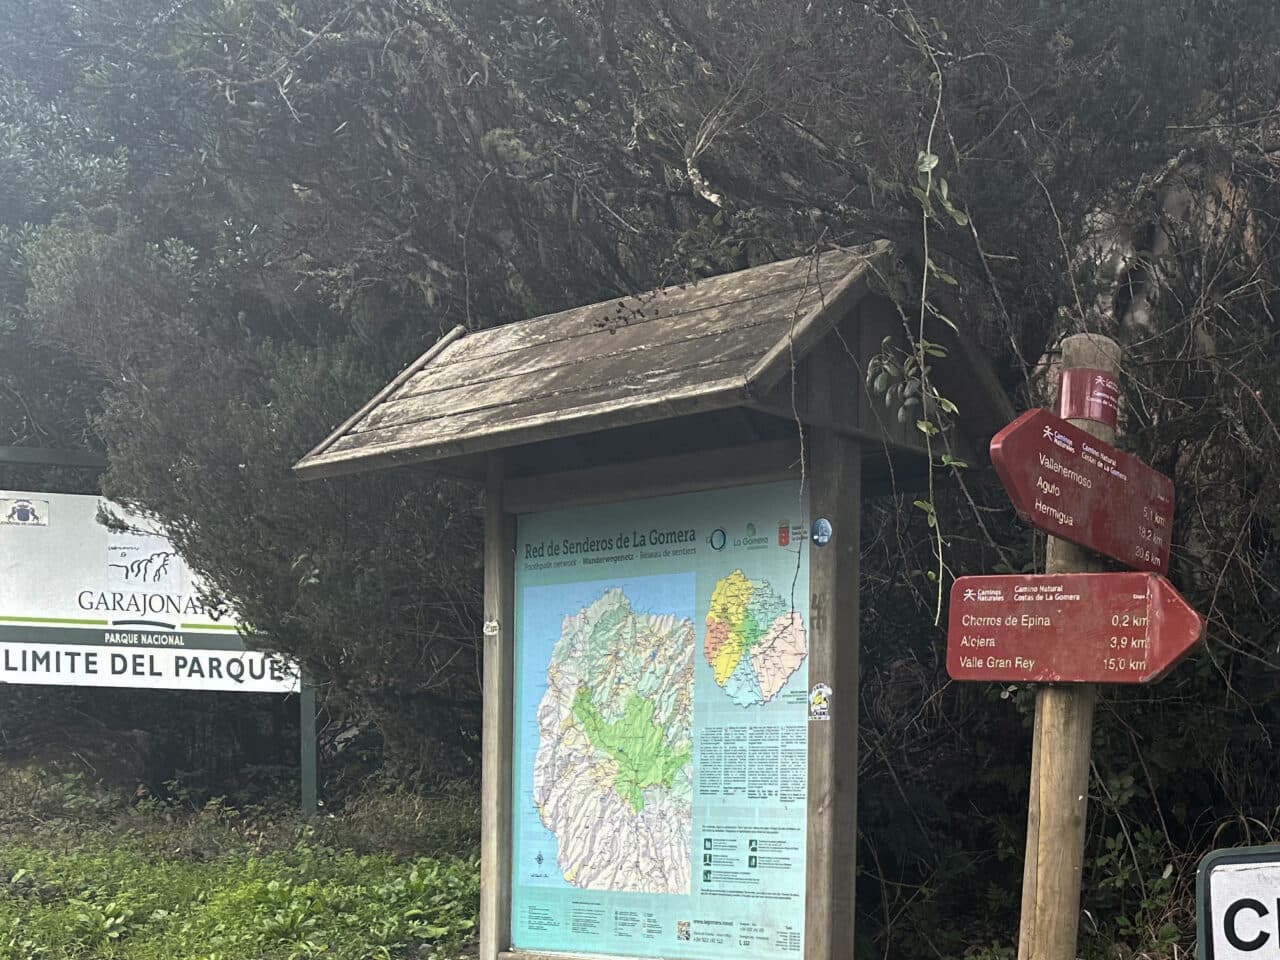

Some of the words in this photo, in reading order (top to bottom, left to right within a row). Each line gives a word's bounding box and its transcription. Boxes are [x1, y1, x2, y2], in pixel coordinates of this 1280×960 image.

[1038, 452, 1092, 489] Vallehermoso
[1154, 512, 1165, 527] km
[1034, 498, 1074, 527] Hermigua
[525, 543, 544, 559] Red
[549, 541, 560, 556] de
[562, 537, 613, 555] Senderos
[616, 533, 629, 549] de
[633, 531, 647, 547] La
[649, 528, 697, 546] Gomera
[1014, 585, 1038, 593] Camino
[1039, 584, 1063, 592] Natural
[78, 590, 207, 617] GARAJONA
[1013, 593, 1034, 602] Costas
[1035, 593, 1044, 601] de
[1045, 593, 1054, 601] La
[1054, 593, 1080, 602] Gomera
[961, 614, 1002, 626] Chorros
[1005, 614, 1018, 626] de
[1021, 614, 1051, 629] Epina
[1111, 614, 1130, 628] 0,2
[1132, 615, 1149, 627] km
[104, 632, 139, 645] PARQUE
[141, 633, 185, 646] NACIONAL
[1109, 636, 1128, 651] 3,9
[1131, 636, 1148, 649] km
[4, 649, 98, 674] LIMITE
[111, 653, 163, 677] DEL
[959, 656, 984, 668] Valle
[986, 656, 1012, 668] Gran
[1014, 656, 1036, 672] Rey
[1103, 658, 1126, 672] 15,0
[1129, 659, 1146, 670] km
